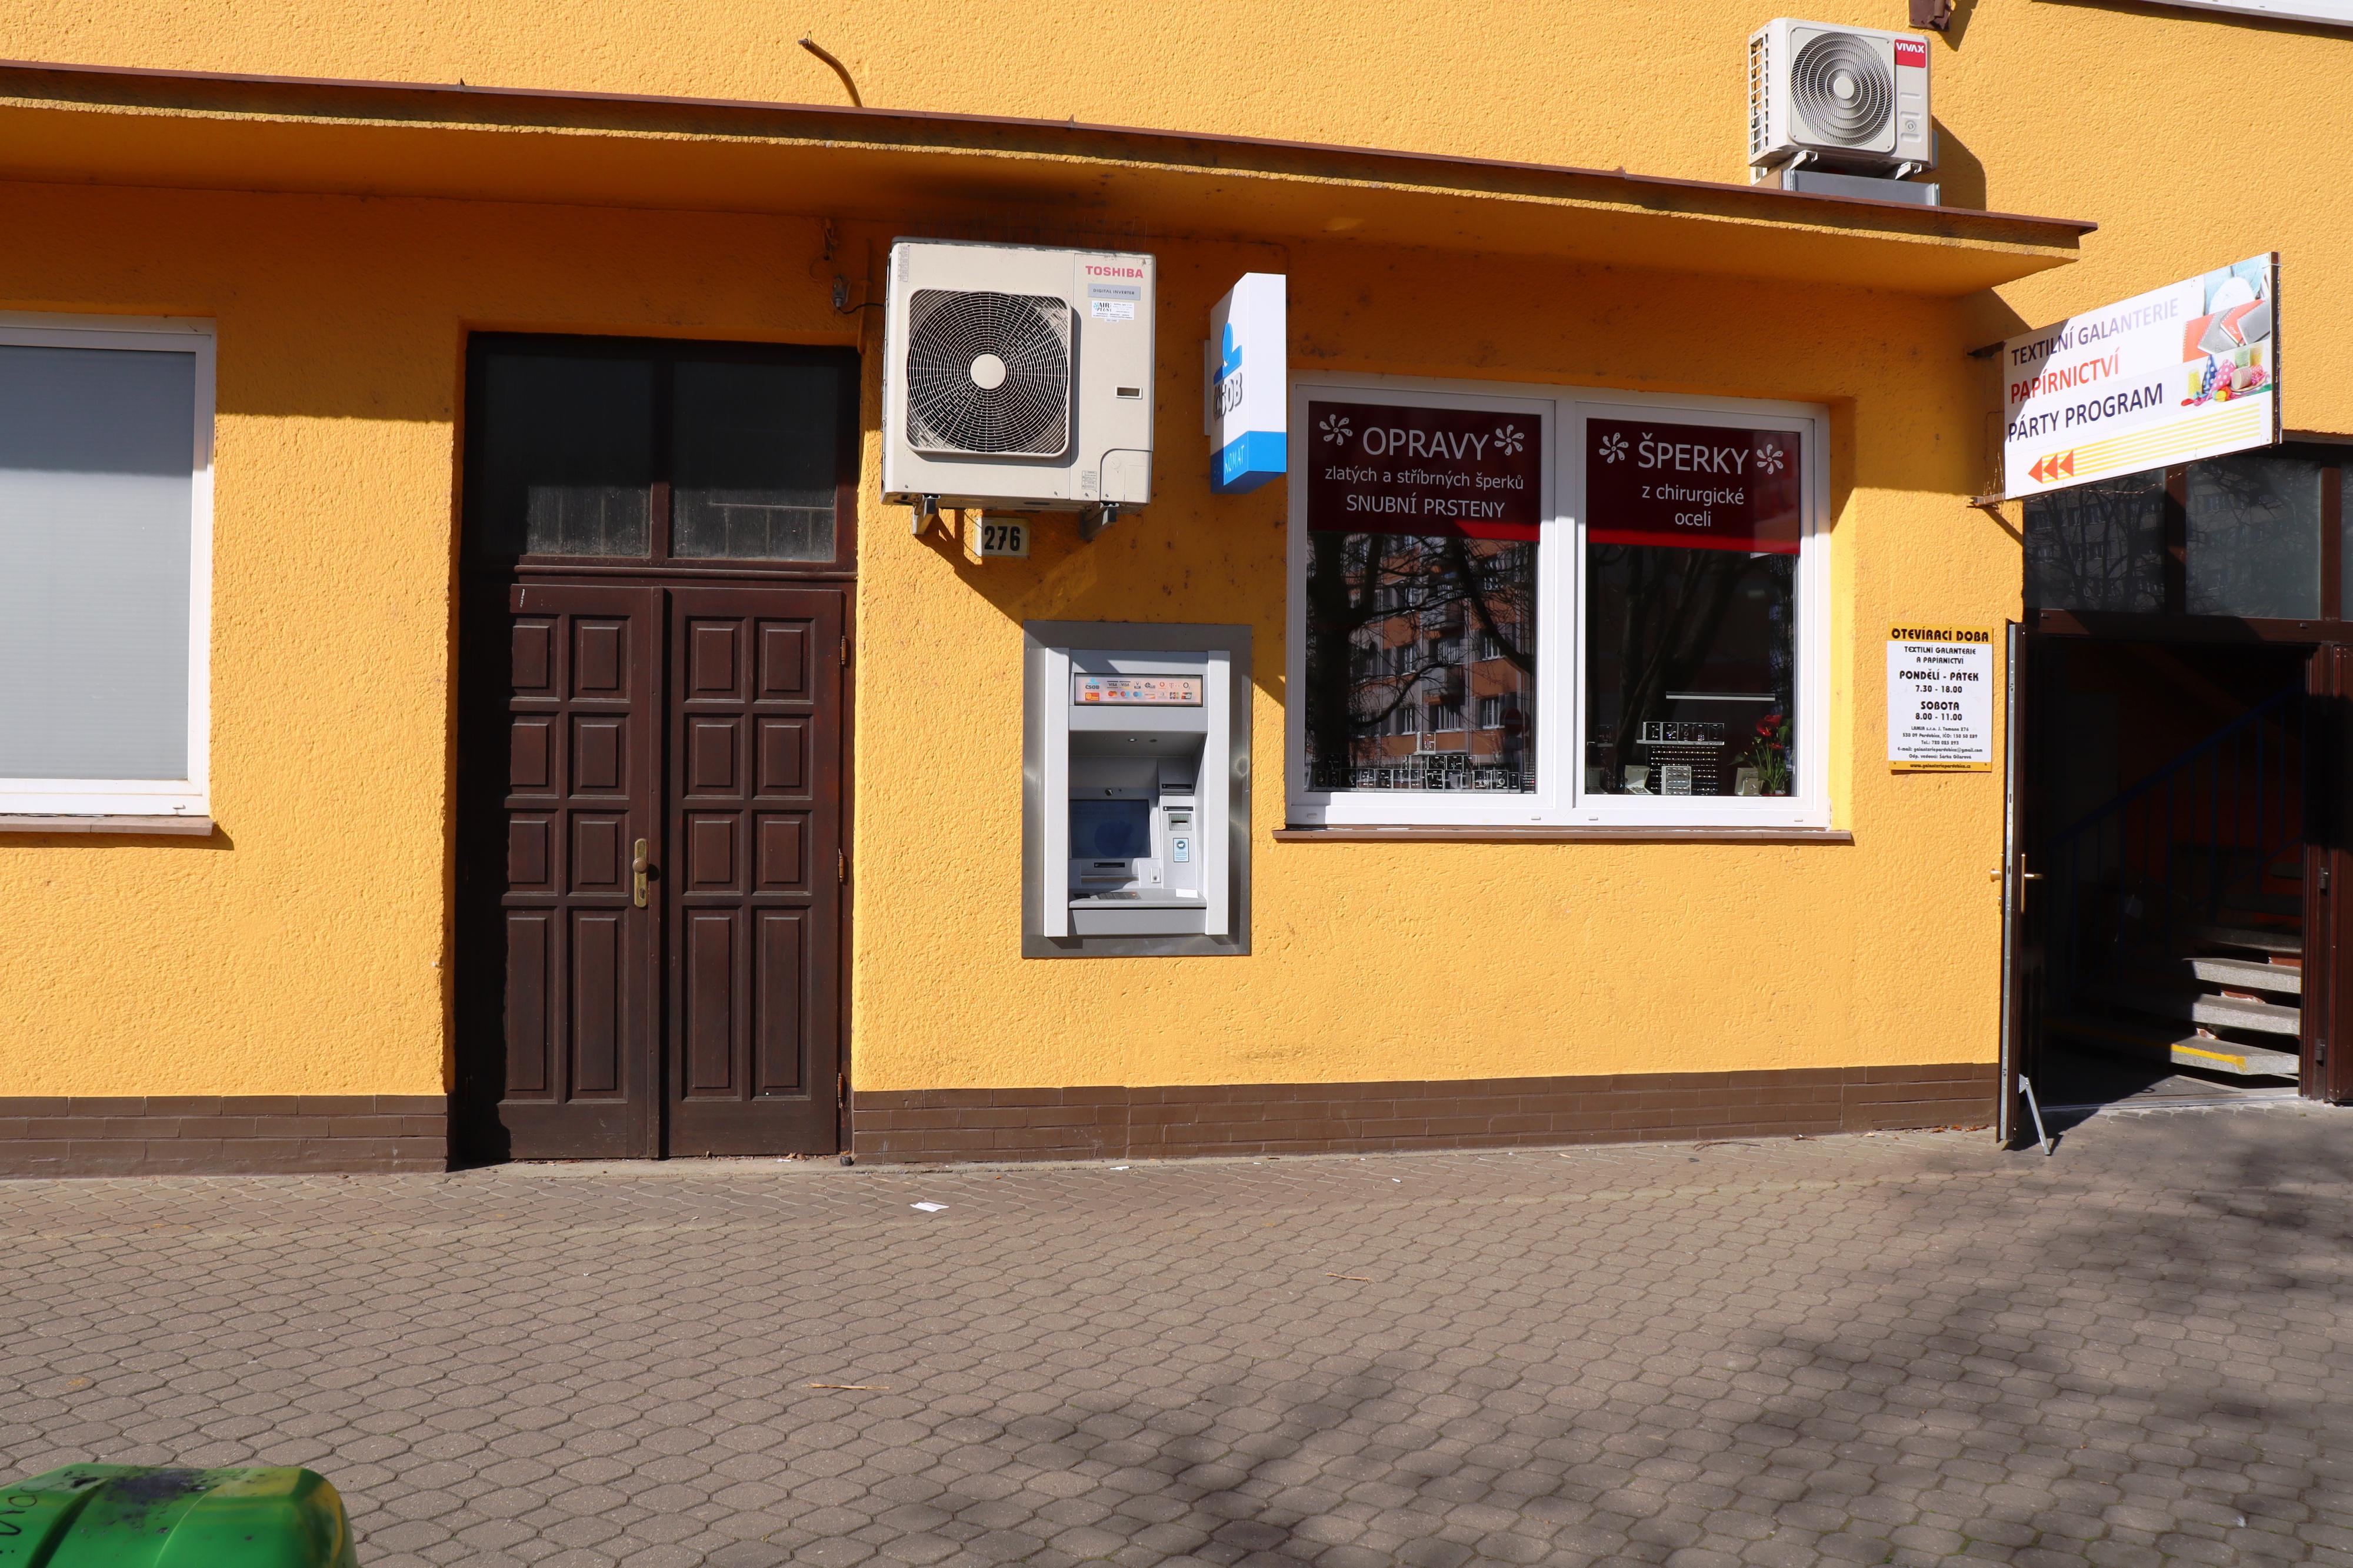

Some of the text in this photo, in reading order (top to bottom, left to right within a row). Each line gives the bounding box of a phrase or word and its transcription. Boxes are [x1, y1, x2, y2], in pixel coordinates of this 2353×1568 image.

[1895, 42, 1925, 54] VIVAX
[1085, 266, 1144, 278] TOSHIBA
[2011, 298, 2178, 366] TEXTILNÍ GALANTERIE
[2011, 347, 2120, 404] PAPÍRNICTVÍ
[2008, 382, 2163, 443] PÁRTY PROGRAM
[1362, 427, 1489, 461] OPRAVY
[1638, 432, 1749, 475] ŠPERKY
[1325, 465, 1524, 491] zlatých a stříbrných šperků
[1347, 492, 1505, 518] SNUBNÍ PRSTENY
[1642, 483, 1744, 506] z chirurgické
[1675, 511, 1711, 526] oceli
[984, 525, 1021, 551] 276
[1891, 626, 1988, 642] OTEVÍRACÍ DOBA
[1904, 645, 1934, 653] TEXTILNÍ
[1923, 655, 1964, 664] PAPÍRNICTVÍ
[1899, 669, 1939, 680] PONDĚLÍ
[1950, 669, 1979, 682] PÁTEK
[1920, 700, 1959, 710] SOBOTA
